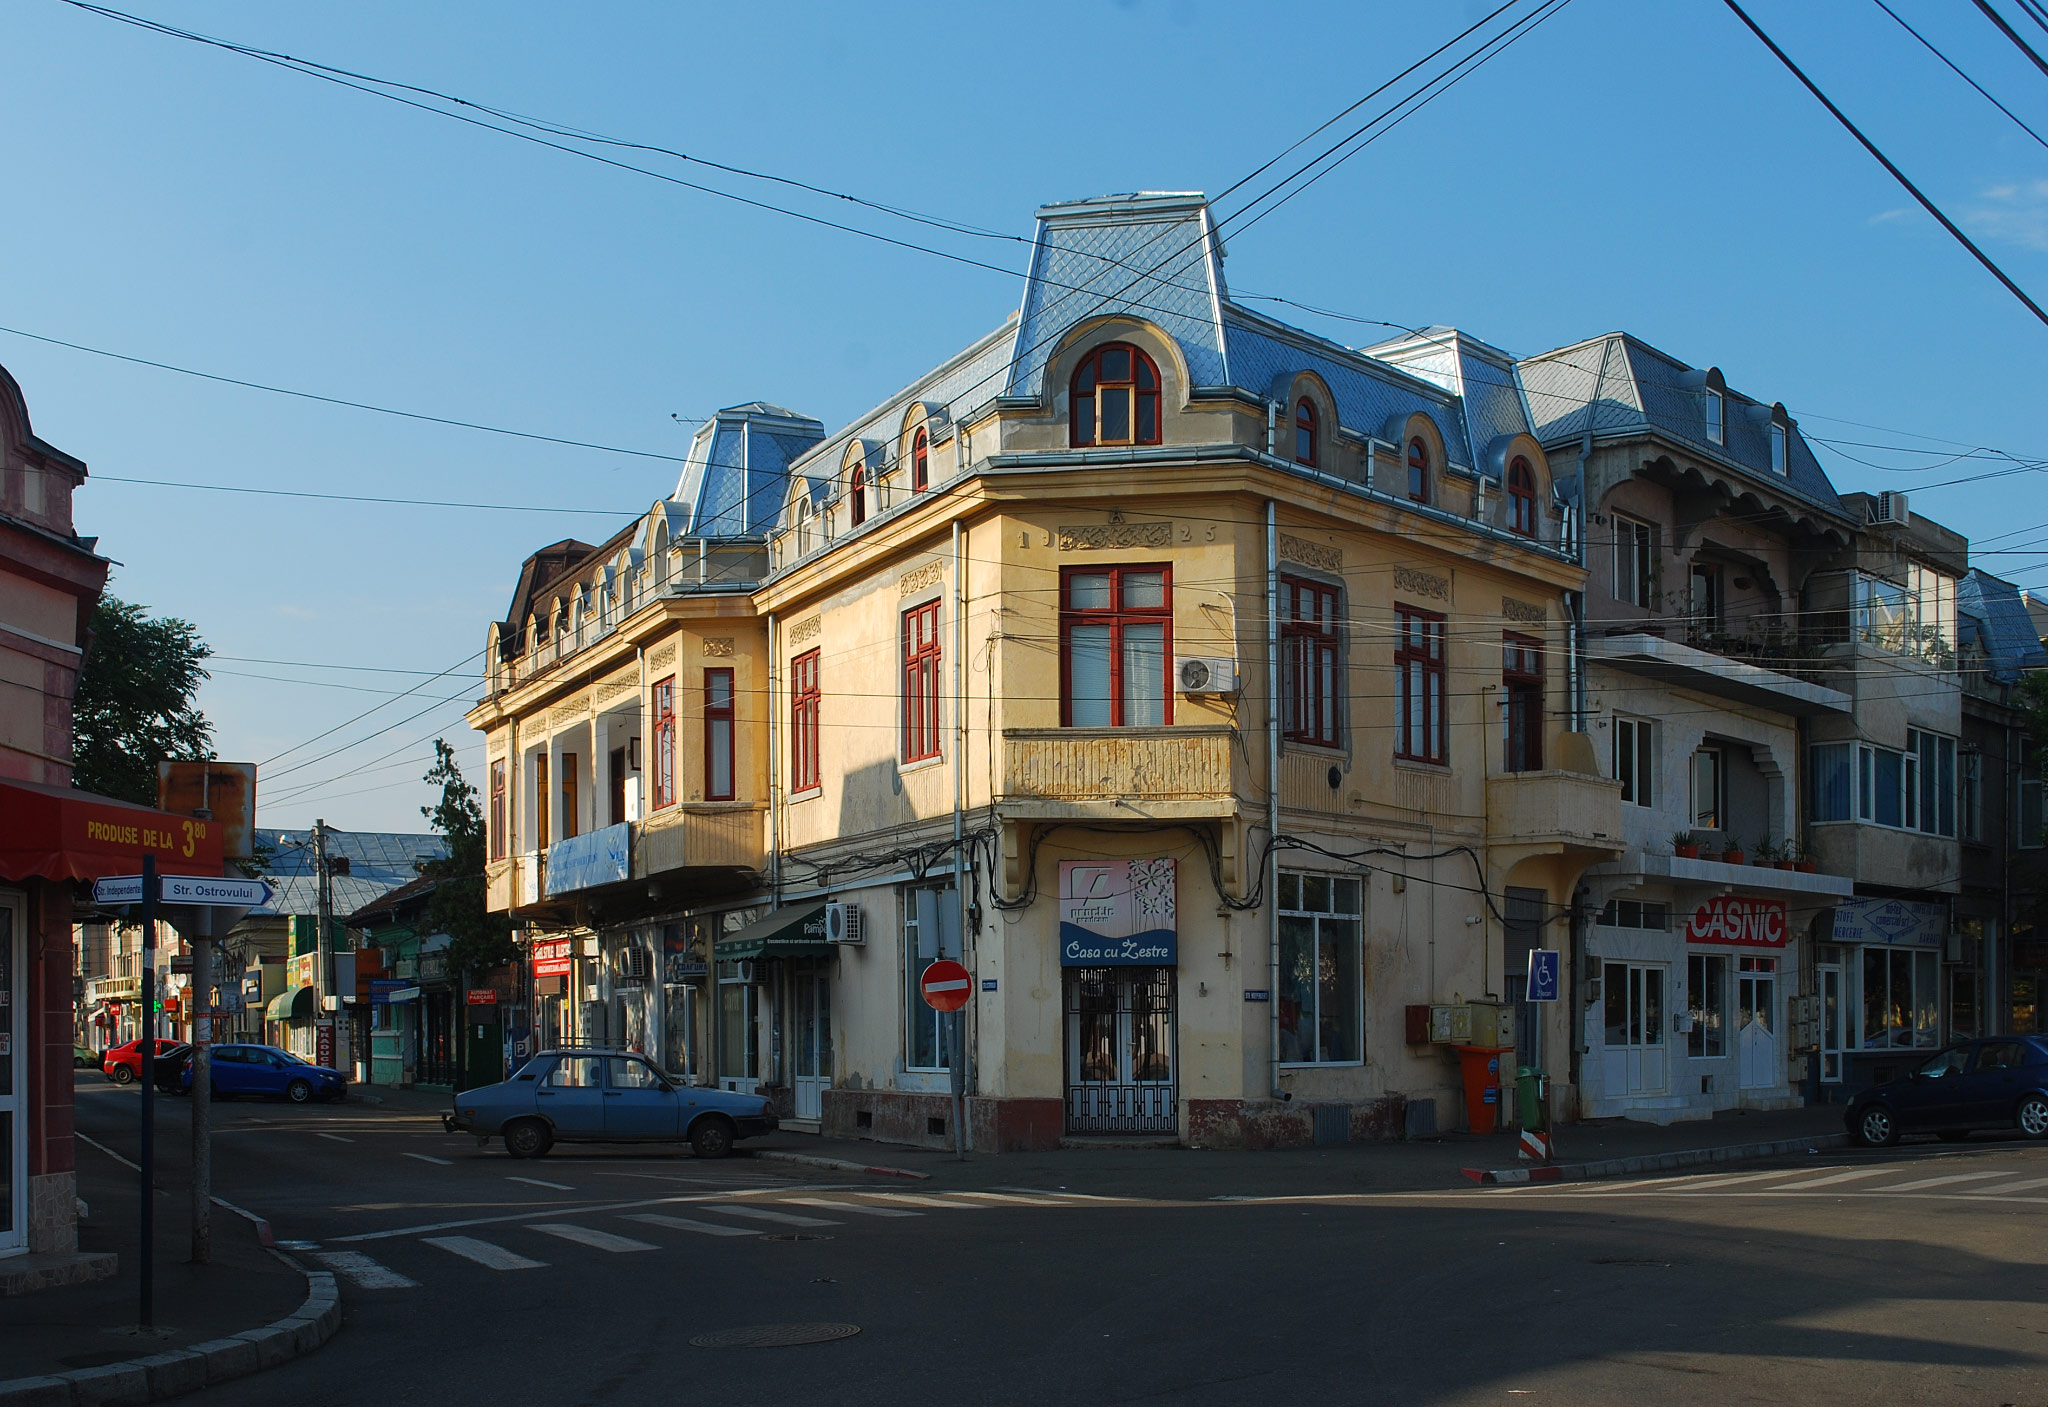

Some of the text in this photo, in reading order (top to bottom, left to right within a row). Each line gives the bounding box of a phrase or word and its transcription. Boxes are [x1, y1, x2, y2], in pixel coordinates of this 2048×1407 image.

[88, 820, 138, 845] PRODUSE
[143, 829, 157, 847] DE
[160, 832, 174, 850] LA
[173, 884, 253, 898] Str. Ostrovului
[1687, 900, 1783, 942] CASNIC
[1836, 911, 1854, 923] STOFE
[804, 923, 827, 936] Pampe
[1066, 938, 1169, 960] Casa cu Zestre
